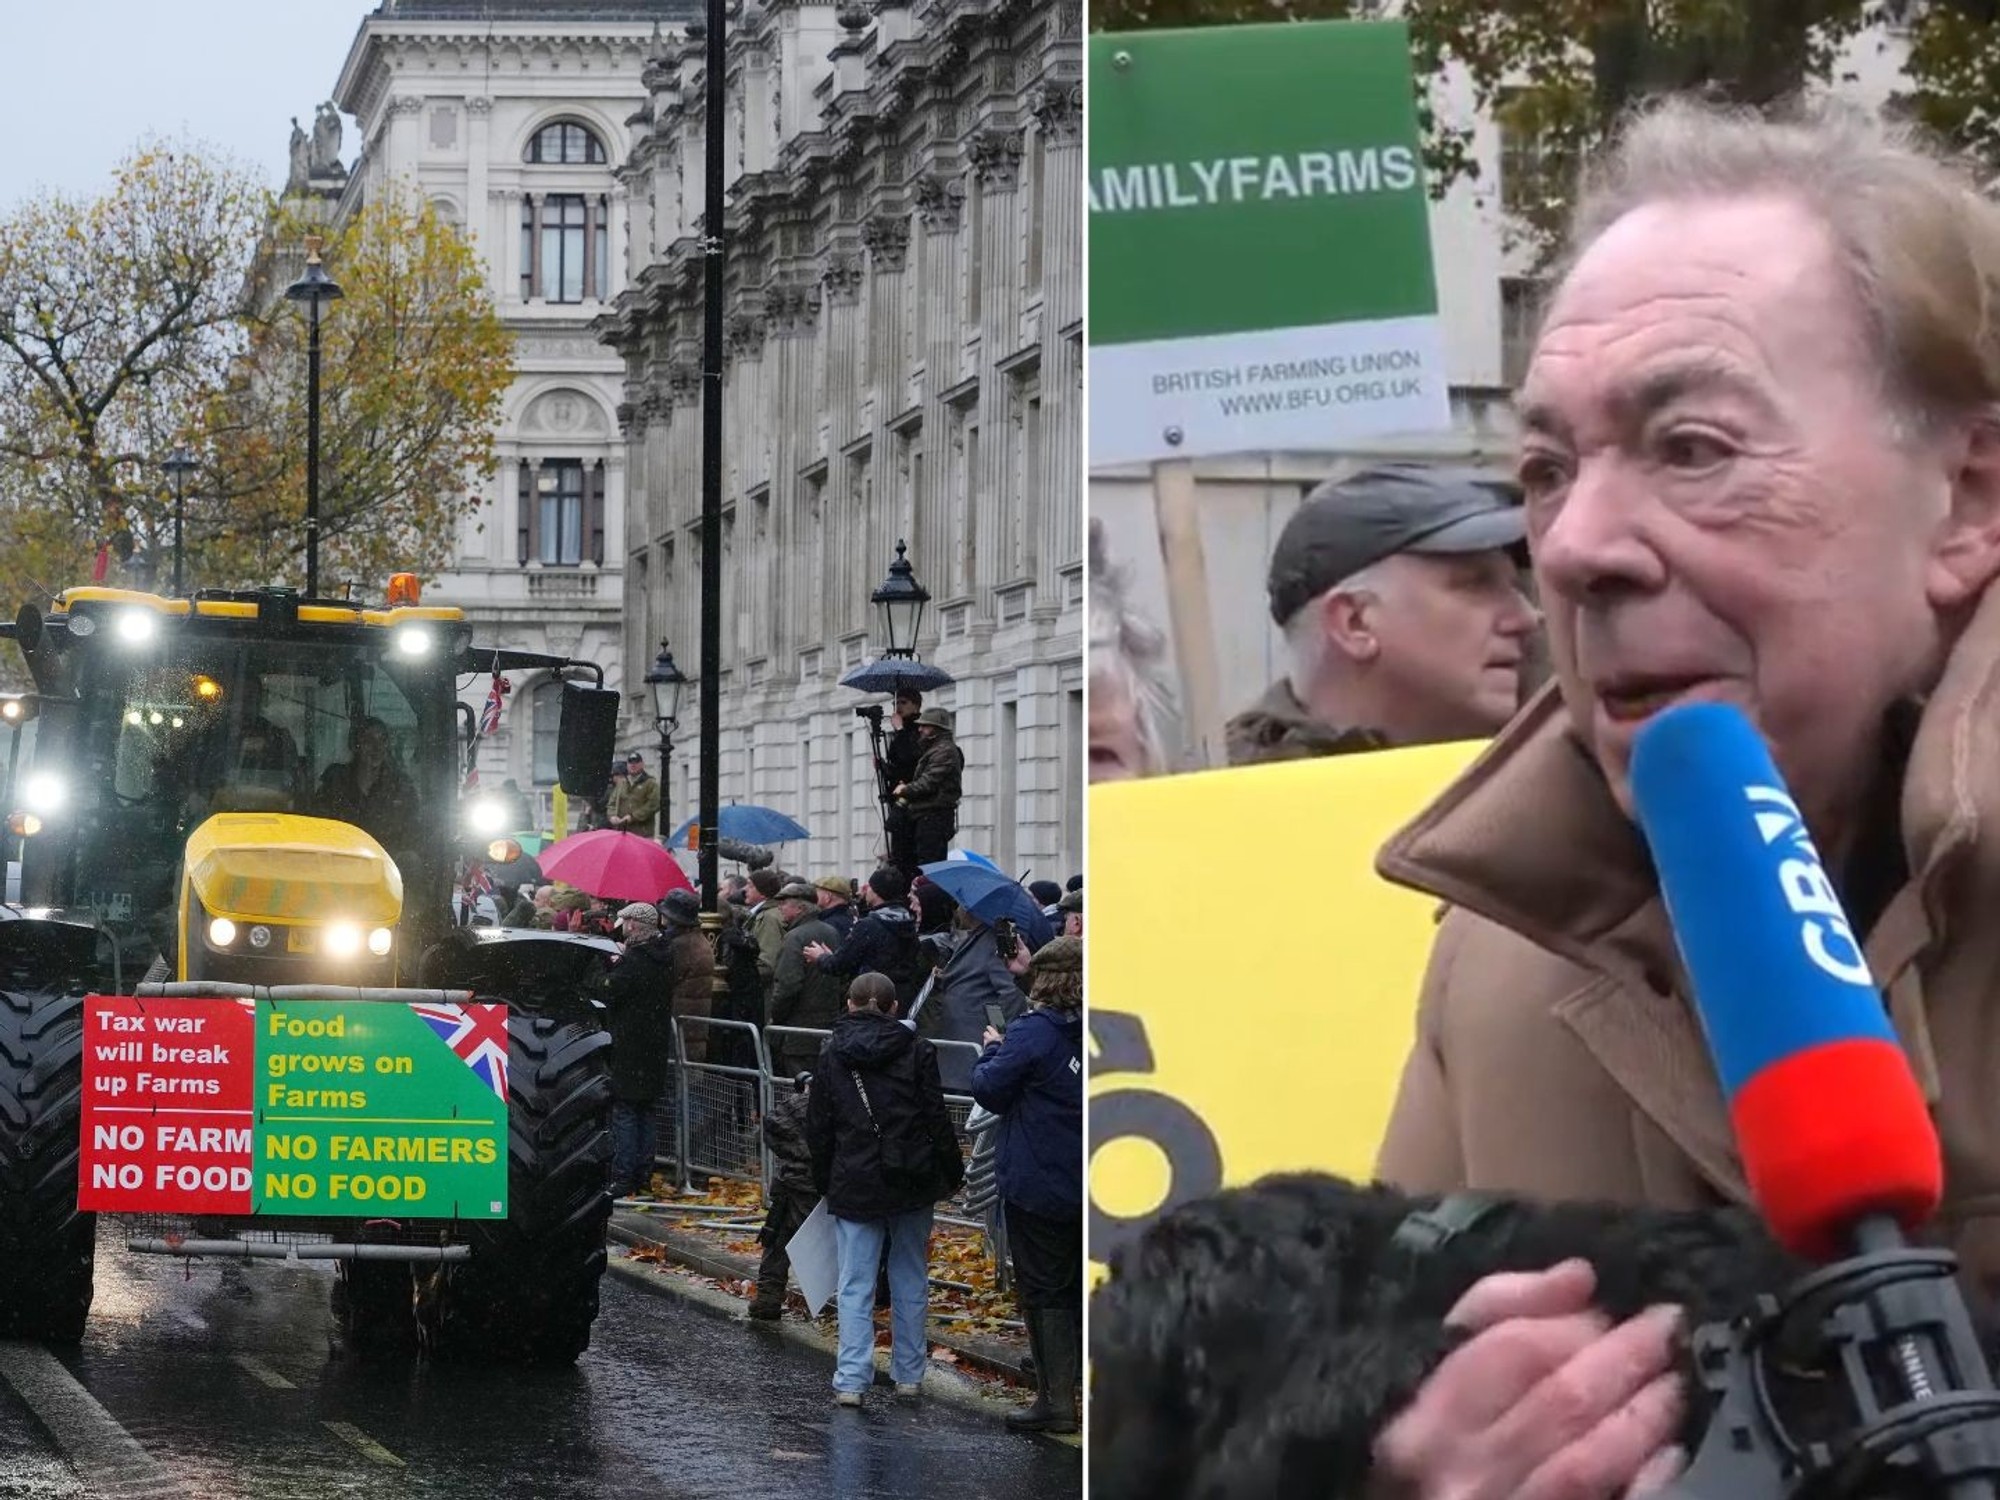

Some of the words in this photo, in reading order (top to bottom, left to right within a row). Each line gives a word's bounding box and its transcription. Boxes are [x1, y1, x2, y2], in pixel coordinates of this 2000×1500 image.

[1152, 367, 1241, 394] BRITISH
[1247, 357, 1346, 384] FARMING
[1352, 350, 1421, 373] UNION
[1220, 379, 1421, 416] WWW.BFU.ORG.UK
[96, 1011, 145, 1032] Tax
[154, 1015, 205, 1033] war
[269, 1013, 345, 1037] Food
[95, 1041, 143, 1062] will
[152, 1043, 230, 1064] break
[268, 1053, 365, 1076] grows
[375, 1055, 413, 1074] on
[94, 1076, 127, 1097] up
[136, 1073, 221, 1095] Farms
[268, 1084, 367, 1109] Farms
[94, 1125, 144, 1151] NO
[267, 1135, 317, 1160] NO
[330, 1136, 497, 1164] FARMERS
[93, 1164, 143, 1189] NO
[156, 1166, 253, 1192] FOOD
[266, 1174, 317, 1198] NO
[330, 1175, 426, 1201] FOOD
